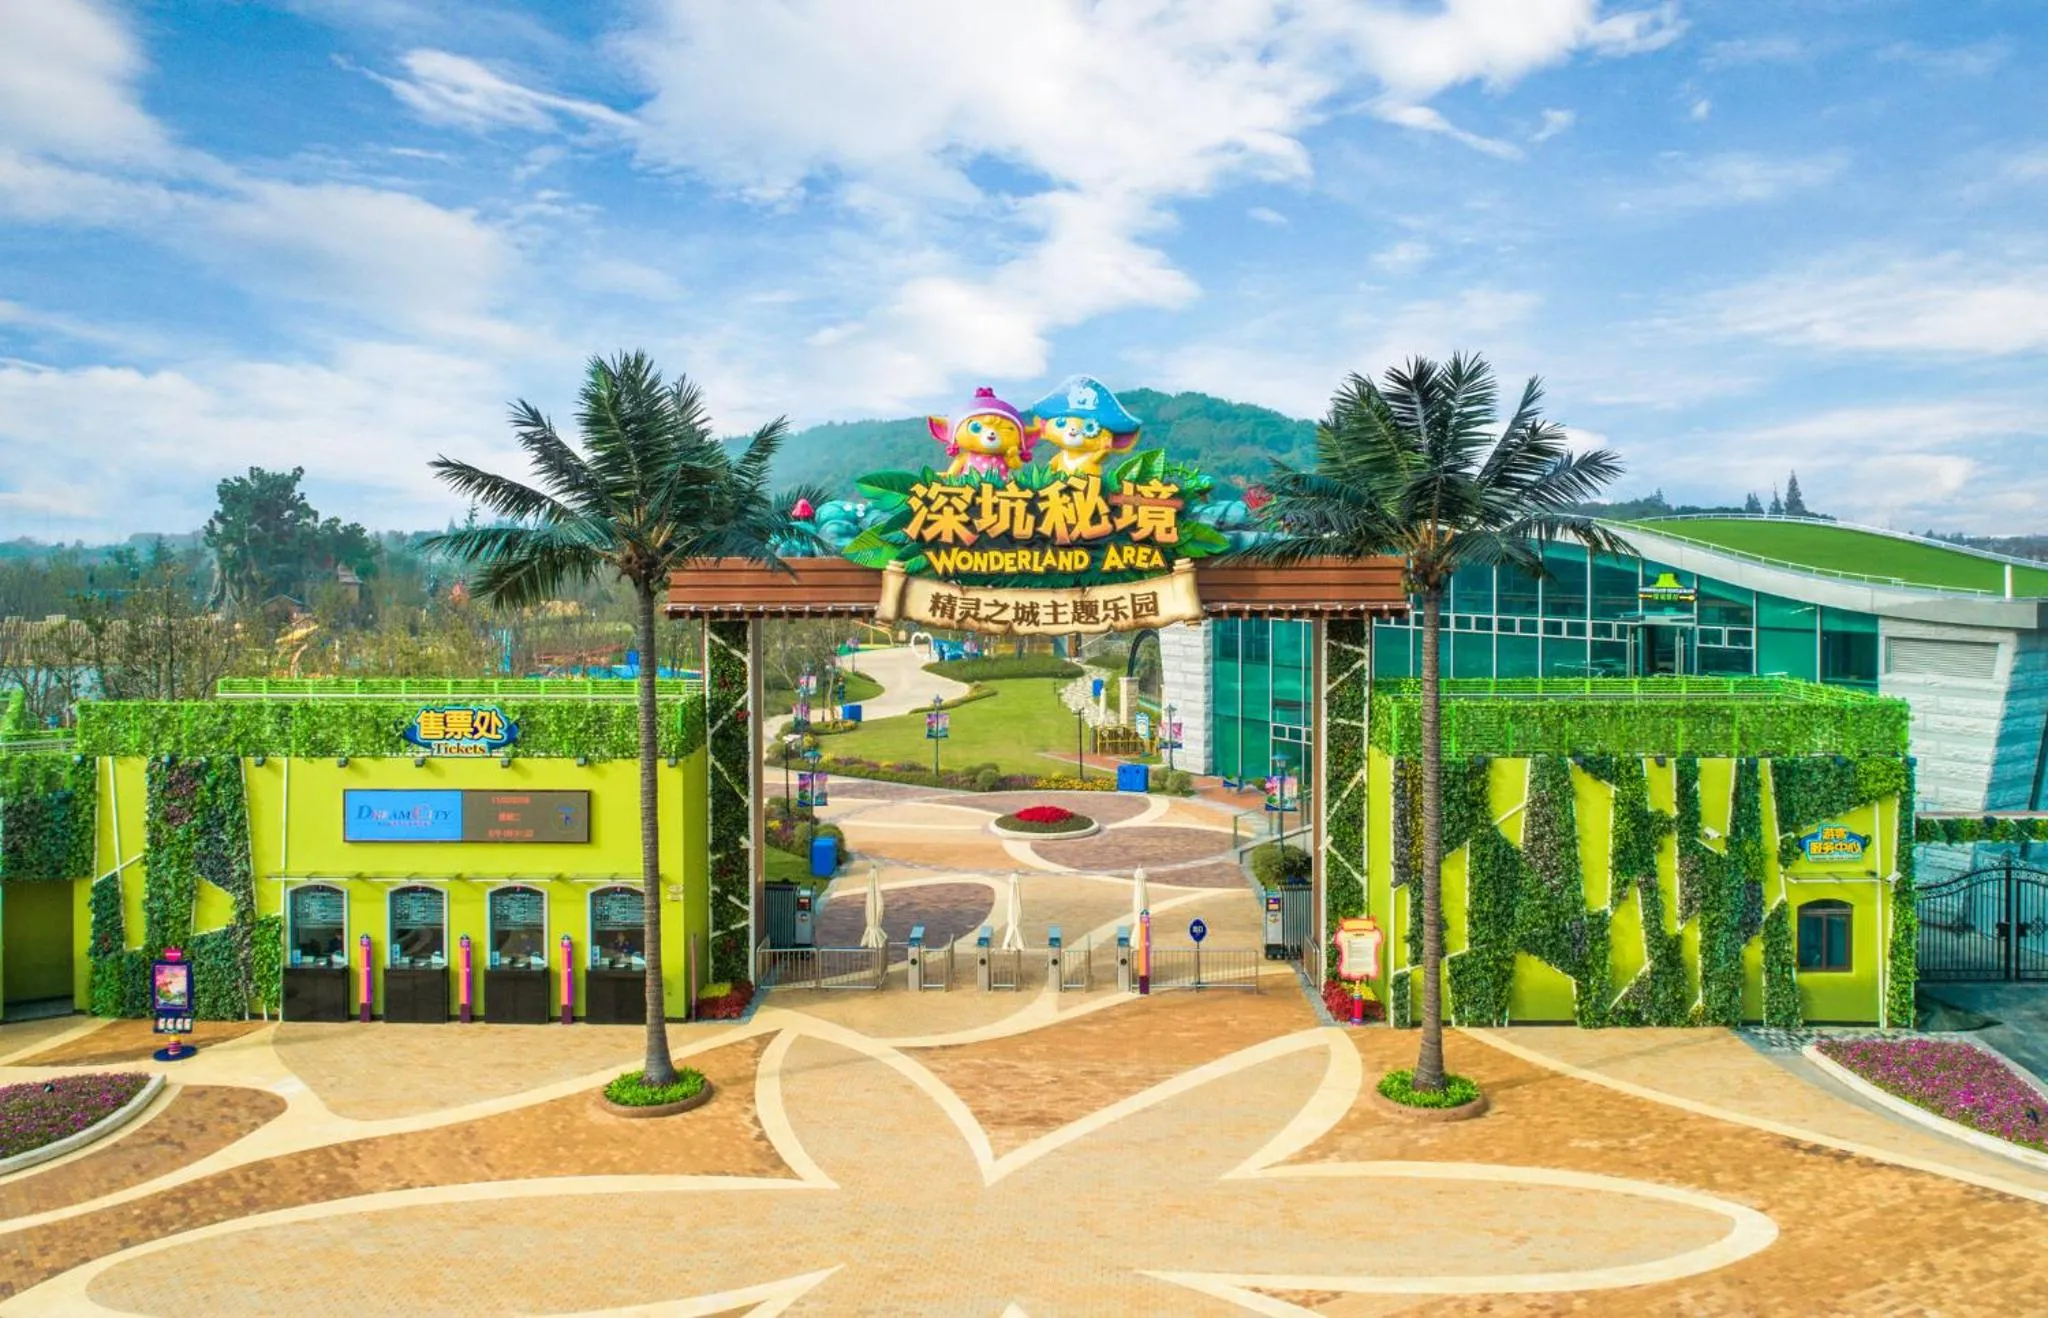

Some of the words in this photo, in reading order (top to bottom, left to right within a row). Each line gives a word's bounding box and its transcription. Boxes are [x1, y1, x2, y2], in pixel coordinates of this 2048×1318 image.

[902, 475, 1182, 546] 深坑秘境
[926, 547, 1089, 575] WONDERLAND
[1102, 545, 1168, 571] AREA
[929, 591, 1160, 626] 精灵之城主题乐园
[416, 710, 503, 739] 售票处
[434, 742, 486, 755] Tickets
